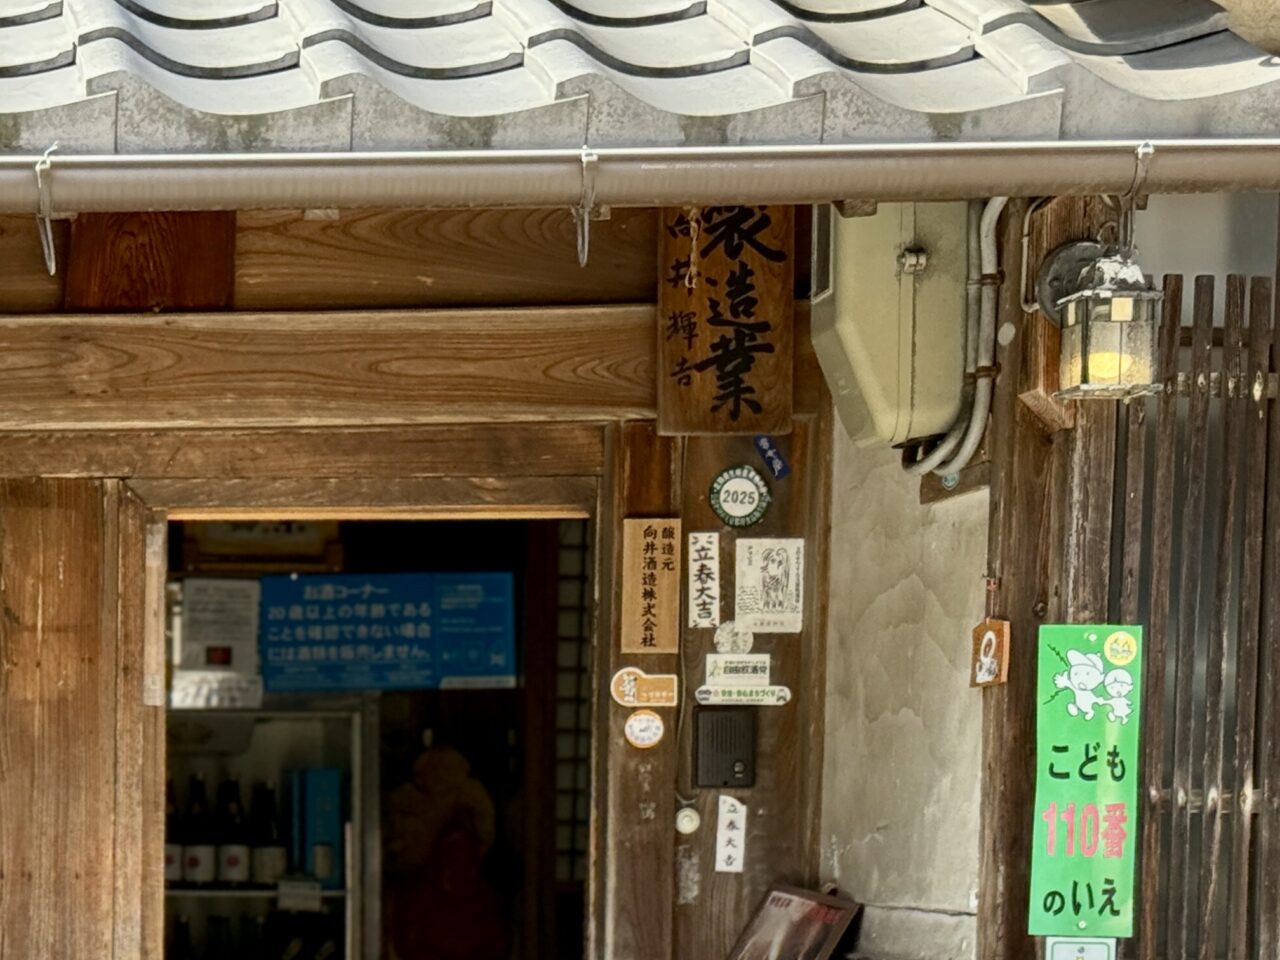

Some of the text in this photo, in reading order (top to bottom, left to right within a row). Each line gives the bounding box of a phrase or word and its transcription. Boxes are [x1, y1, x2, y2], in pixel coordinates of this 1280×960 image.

[722, 489, 756, 505] 2025
[661, 526, 676, 572] 醸造元
[639, 525, 658, 648] 向井酒造株式会社
[692, 546, 718, 619] 立春大吉
[1049, 741, 1126, 782] こども
[724, 803, 740, 867] 立春大吉
[1042, 802, 1128, 858] 110番
[1043, 877, 1121, 917] のいえ
